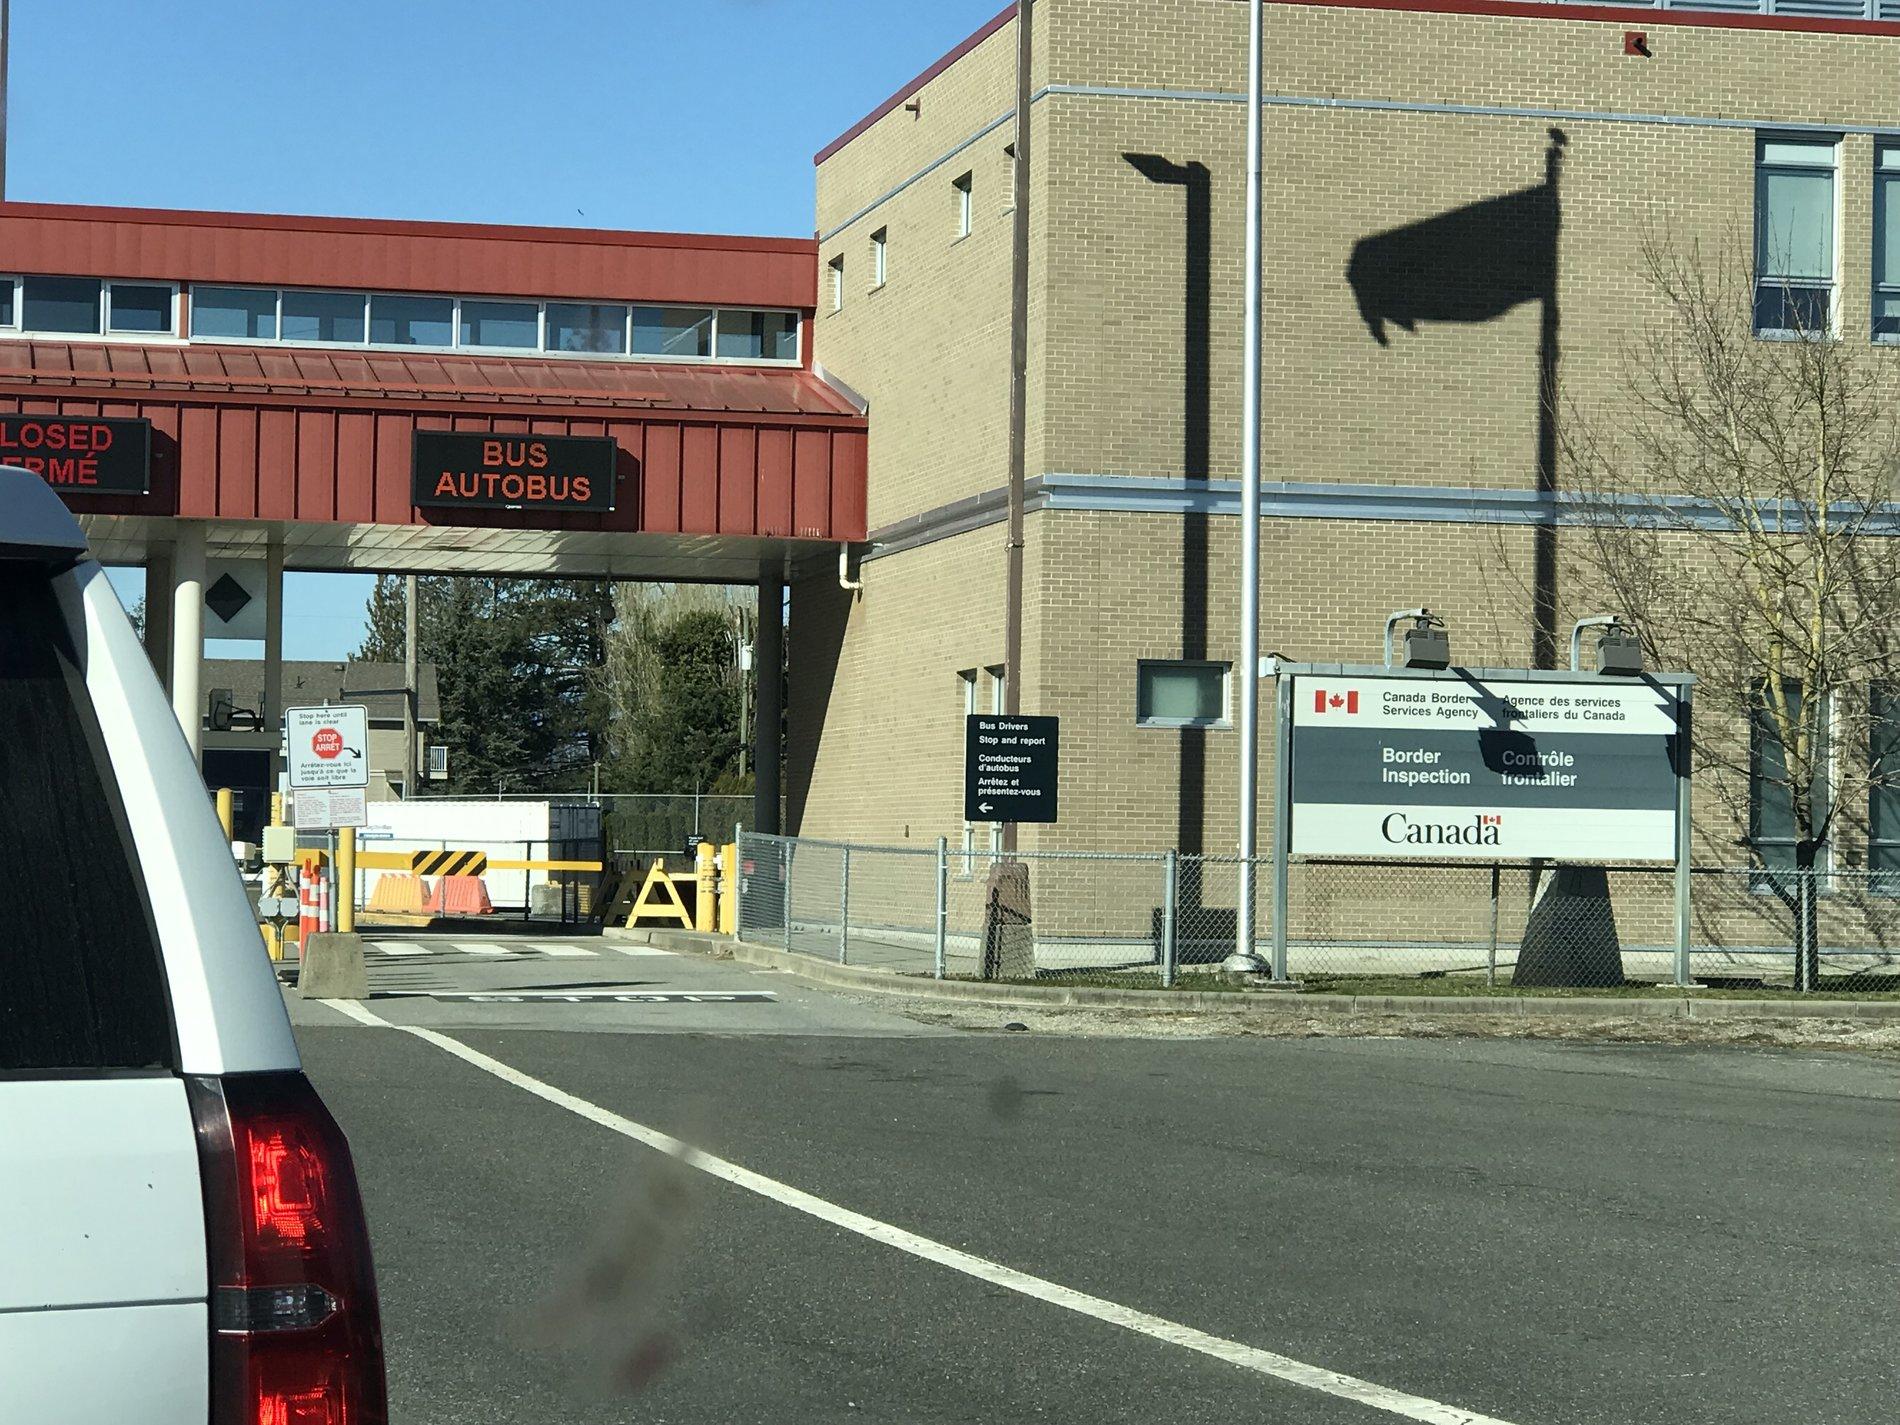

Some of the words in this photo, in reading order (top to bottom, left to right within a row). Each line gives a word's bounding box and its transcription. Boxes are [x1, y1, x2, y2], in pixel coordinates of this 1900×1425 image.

[0, 422, 113, 451] LOSED
[483, 441, 548, 468] BUS
[2, 451, 98, 484] RMÉ
[434, 472, 592, 501] AUTOBUS
[1383, 692, 1427, 703] Canada
[1431, 693, 1470, 705] Border
[1503, 695, 1545, 709] Agence
[1550, 695, 1571, 707] des
[1575, 696, 1621, 708] services
[1383, 705, 1432, 716] Services
[1436, 706, 1479, 719] Agency
[1503, 708, 1559, 720] frontaliers
[1564, 710, 1578, 720] du
[1583, 710, 1626, 721] Canada
[979, 721, 996, 729] Bus
[998, 722, 1029, 730] Drivers
[317, 733, 338, 743] STOP
[979, 735, 999, 745] Stop
[1001, 736, 1017, 744] and
[1020, 737, 1046, 746] report
[315, 741, 340, 751] ARRÊT
[978, 754, 1032, 763] Conducteurs
[1383, 747, 1442, 764] Border
[1502, 750, 1575, 767] Contrôle
[978, 764, 1020, 772] d'autobus
[978, 777, 1008, 786] Arrêtez
[1383, 768, 1471, 787] Inspection
[1502, 769, 1578, 787] frontalier
[978, 786, 1041, 796] présentez-vous
[1382, 812, 1503, 846] Canada
